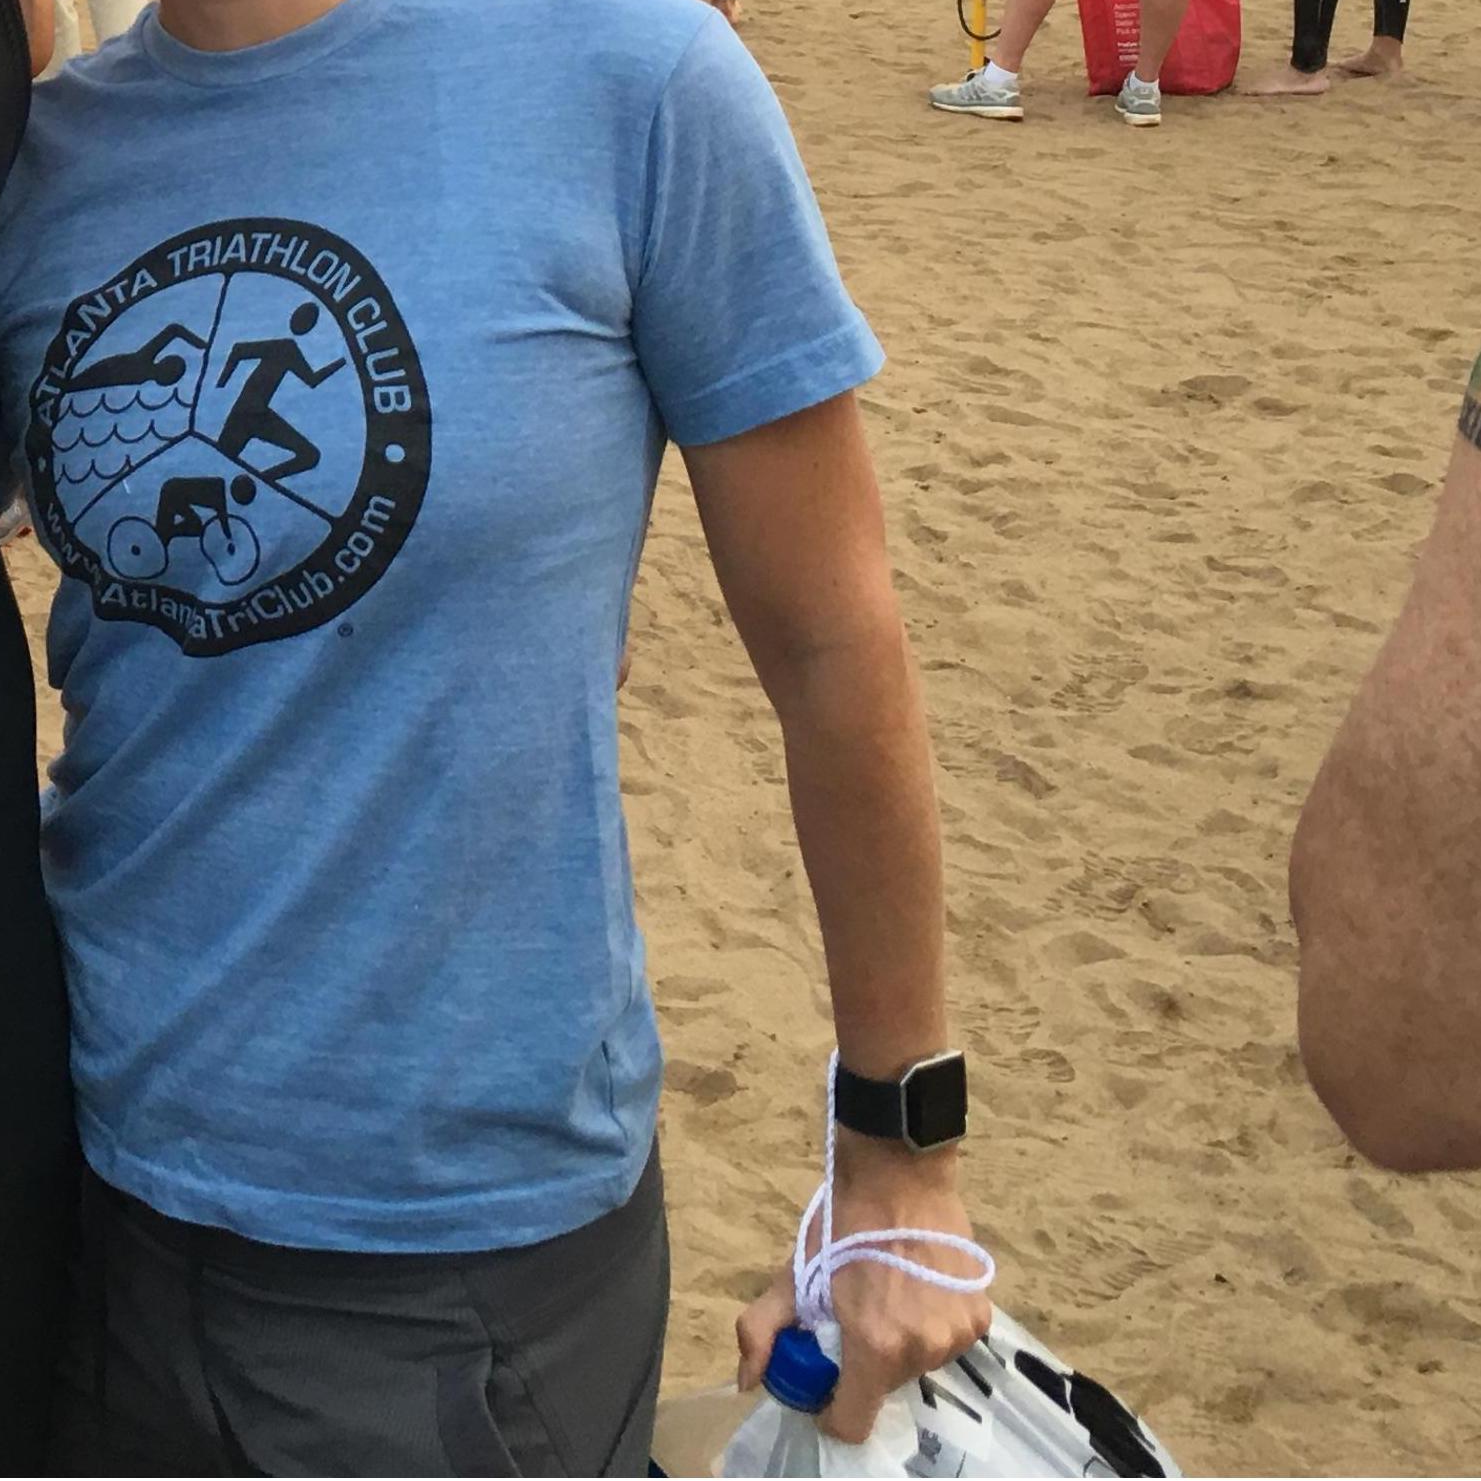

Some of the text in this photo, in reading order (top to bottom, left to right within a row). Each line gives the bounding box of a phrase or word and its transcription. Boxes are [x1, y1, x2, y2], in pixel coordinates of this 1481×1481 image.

[35, 231, 413, 427] ATLANTA TRIATHLON CLUB
